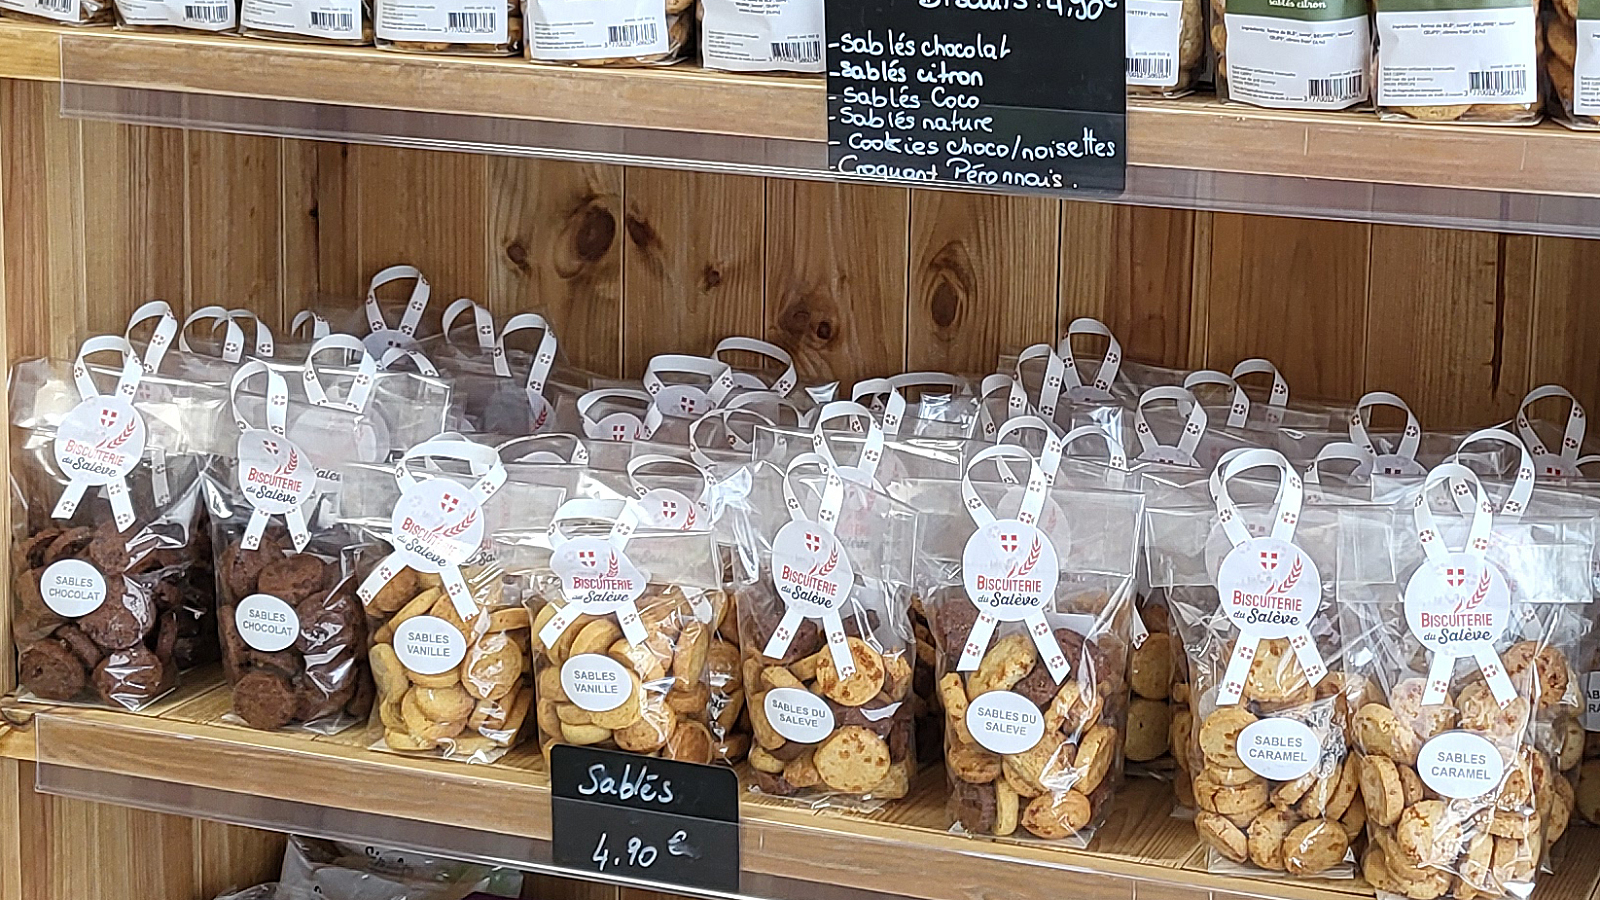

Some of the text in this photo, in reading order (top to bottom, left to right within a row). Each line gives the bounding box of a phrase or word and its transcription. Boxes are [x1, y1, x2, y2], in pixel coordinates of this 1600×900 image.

[916, 61, 984, 87] citron
[931, 86, 980, 109] Coco
[923, 111, 993, 133] nature
[72, 456, 117, 478] Salève
[255, 485, 298, 505] Salève
[54, 575, 94, 588] SABLES
[48, 587, 101, 601] CHOCOLAT
[791, 585, 833, 609] Salève
[989, 591, 1041, 607] Salève
[249, 608, 286, 623] SABLES
[1246, 607, 1301, 626] Salève
[242, 620, 293, 636] CHOCOLAT
[407, 631, 450, 645] SABLES
[1437, 628, 1493, 645] Salève
[406, 644, 451, 658] VANILLE
[573, 669, 616, 682] SABLES
[573, 681, 619, 695] VANILLE
[771, 699, 826, 719] SABLES DU
[977, 706, 1037, 724] SABLES DU
[778, 712, 819, 728] SALEVE
[985, 721, 1027, 736] SALEVE
[1254, 735, 1303, 748] SABLES
[1249, 747, 1308, 763] CARAMEL
[1437, 751, 1487, 765] SABLES
[1431, 766, 1491, 780] CARAMEL
[578, 763, 674, 804] Sablés
[592, 832, 658, 872] 4.90
